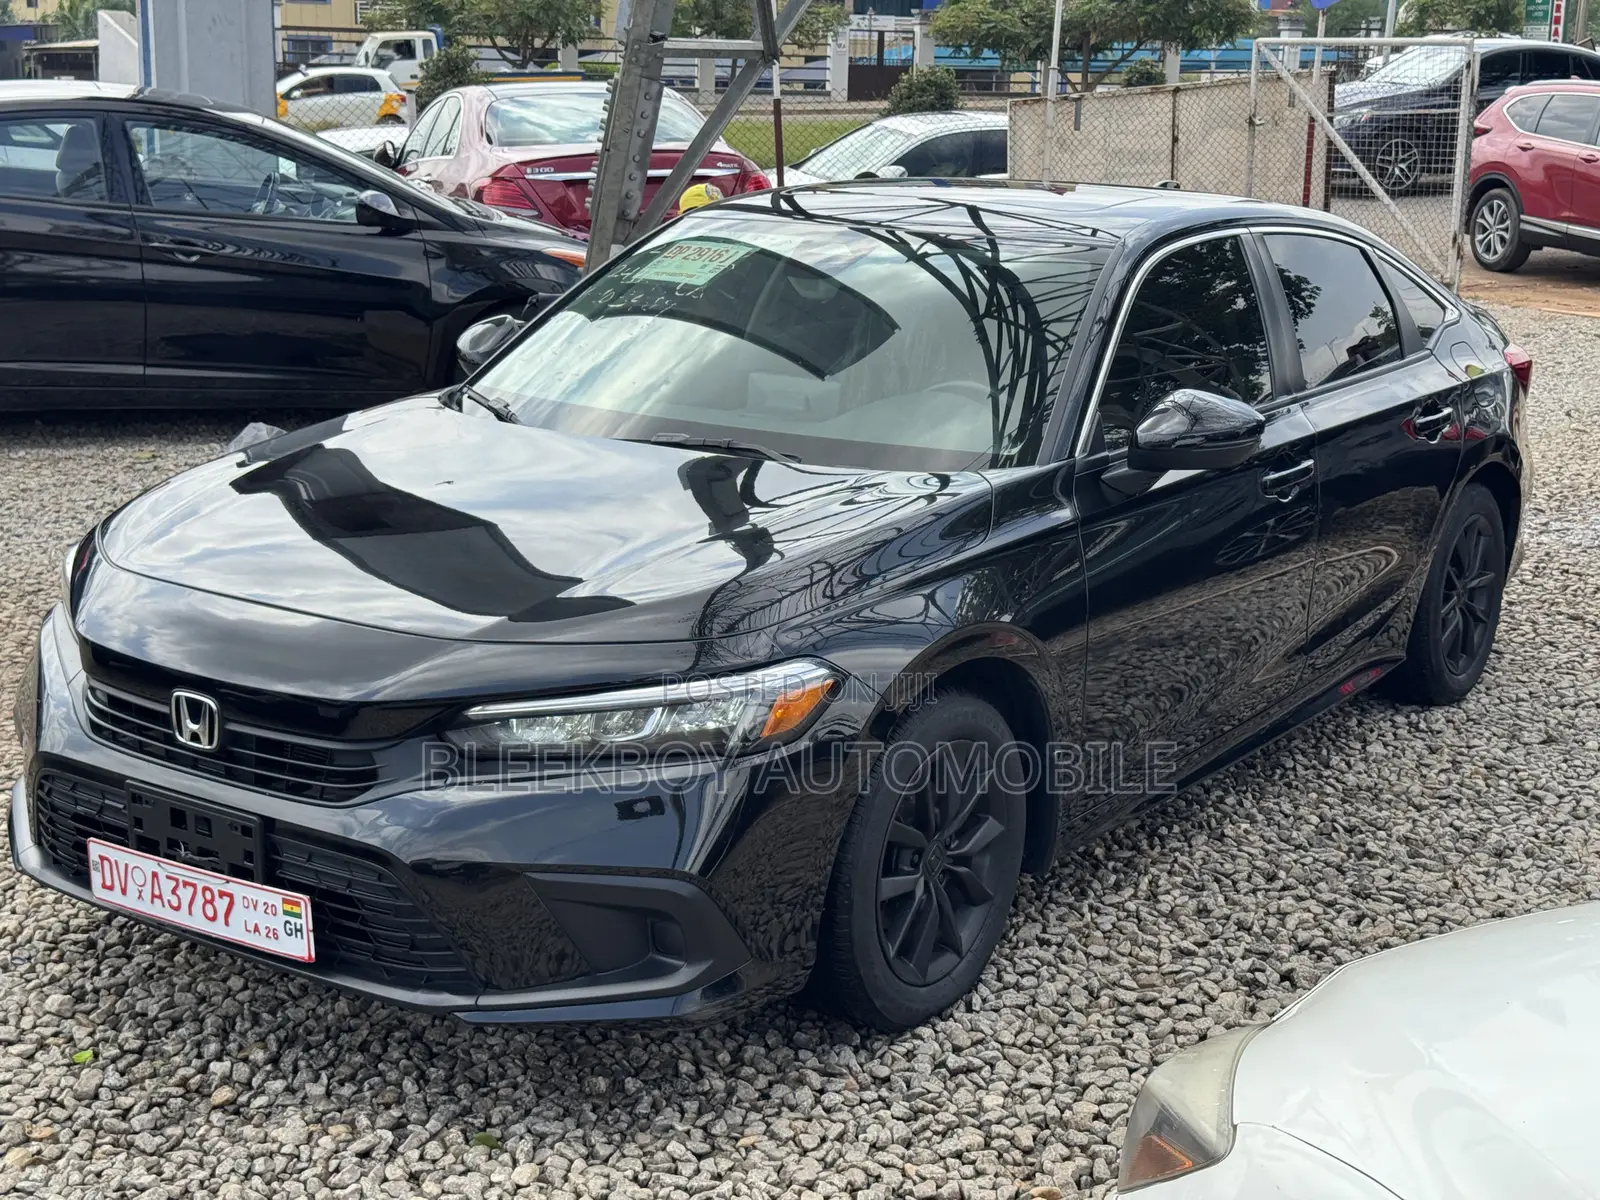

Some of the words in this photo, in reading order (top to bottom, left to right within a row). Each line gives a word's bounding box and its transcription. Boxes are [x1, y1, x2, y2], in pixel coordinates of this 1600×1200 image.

[98, 854, 129, 896] DV
[242, 895, 259, 912] DV
[263, 901, 278, 917] 20
[244, 919, 262, 937] LA
[265, 925, 280, 941] 26
[283, 919, 305, 940] GH
